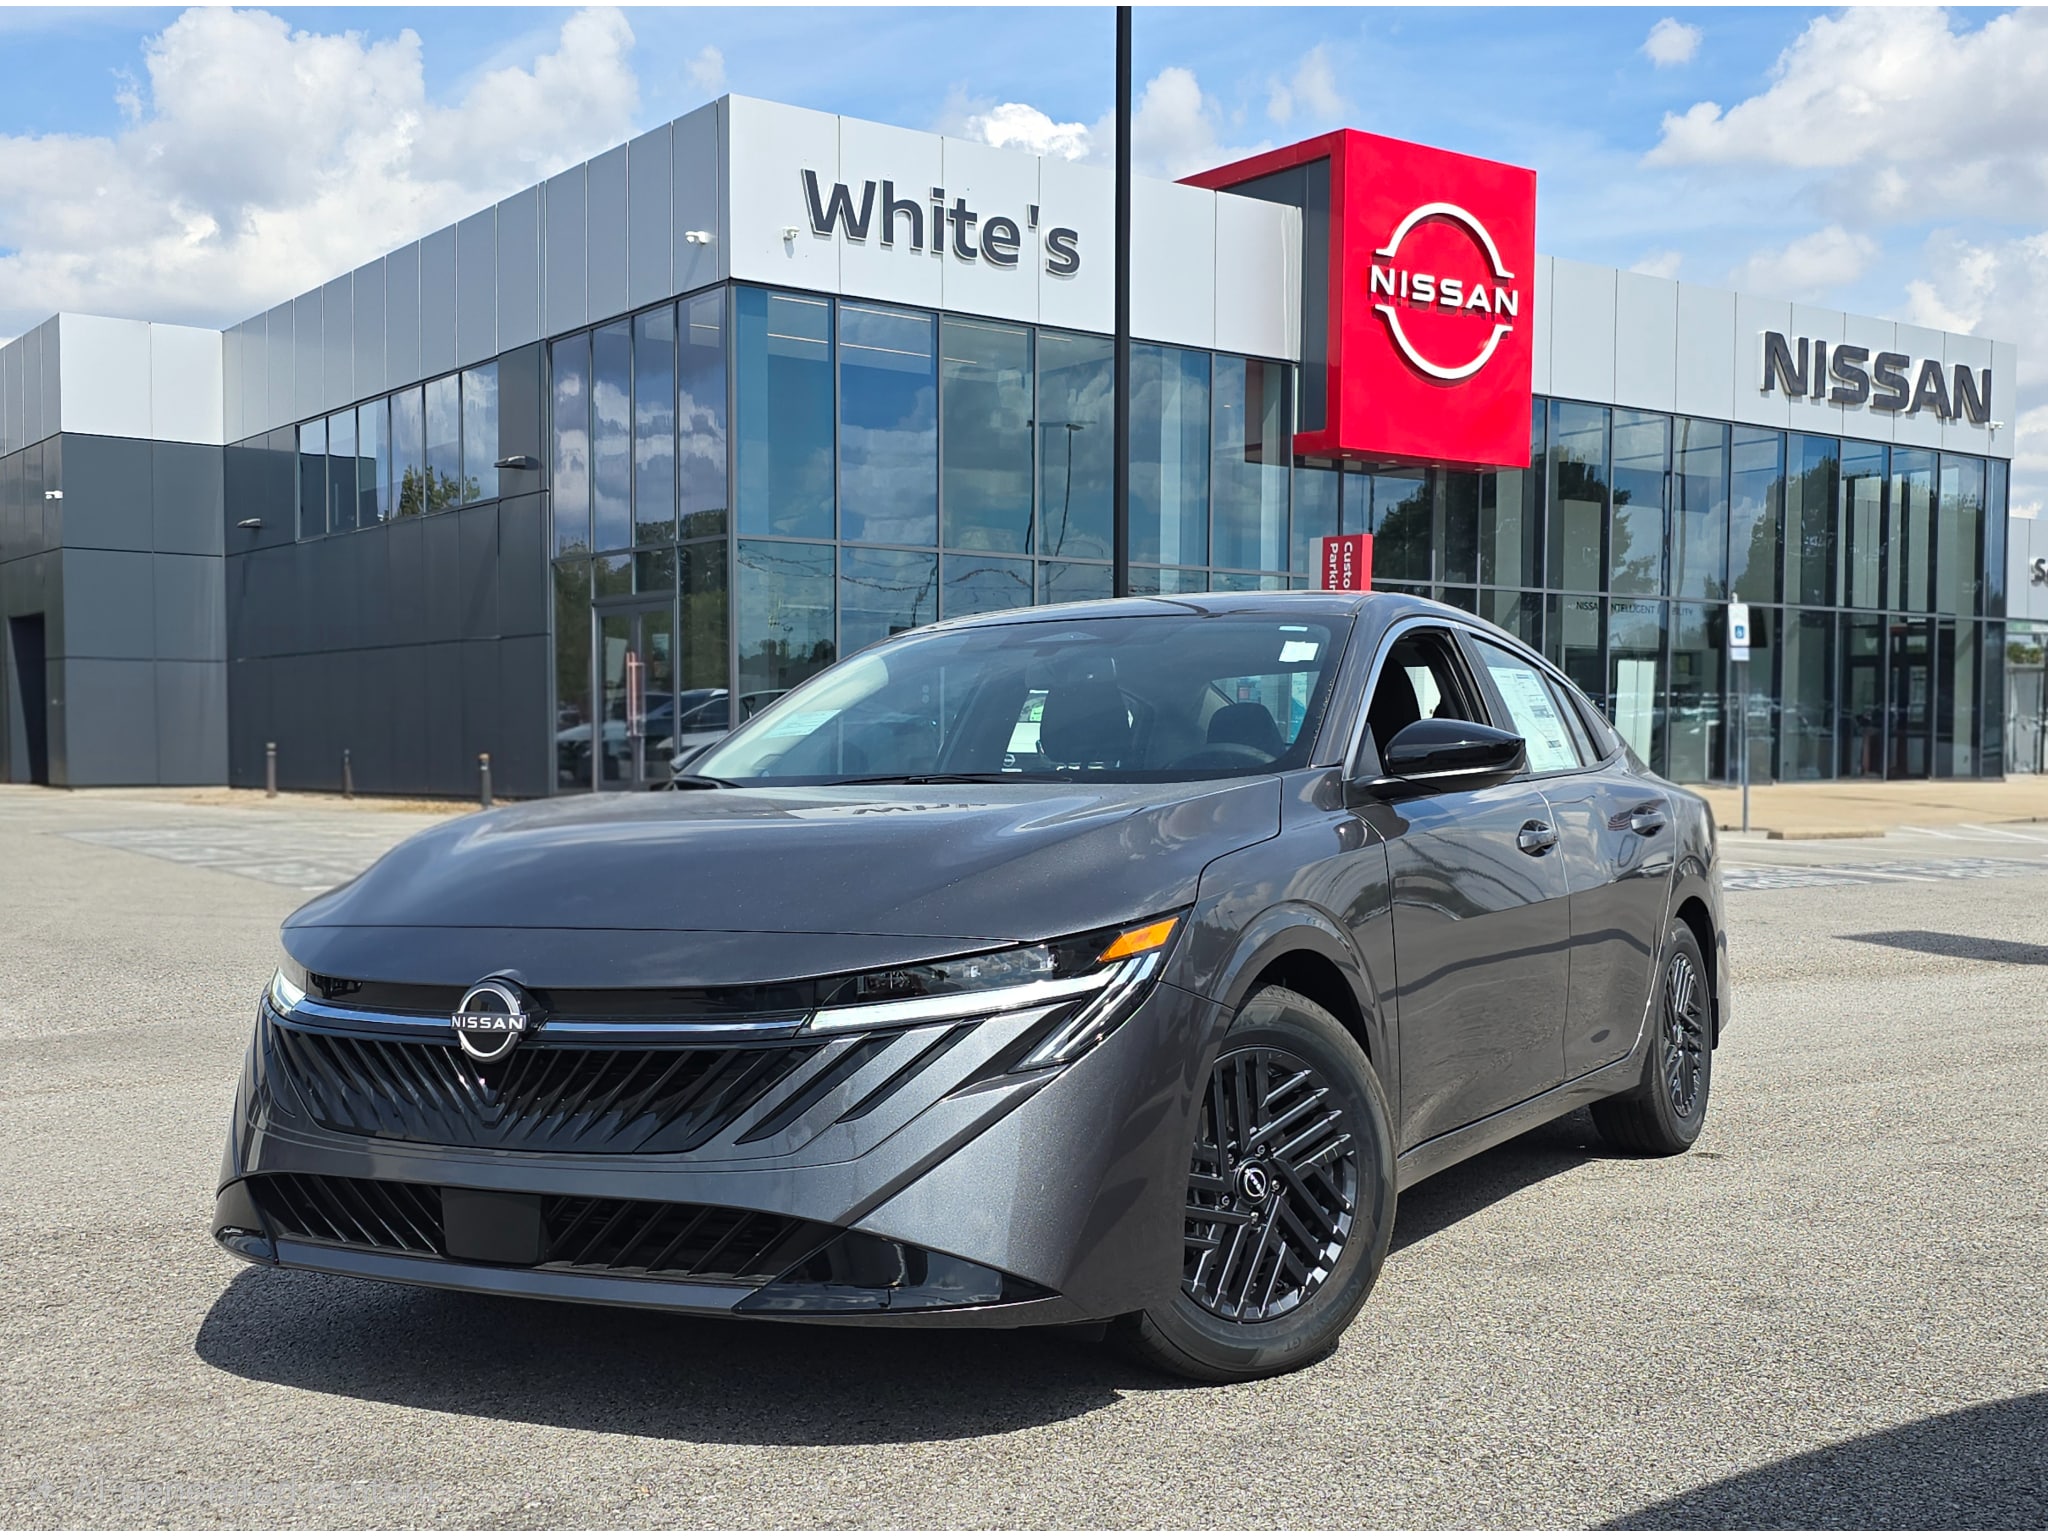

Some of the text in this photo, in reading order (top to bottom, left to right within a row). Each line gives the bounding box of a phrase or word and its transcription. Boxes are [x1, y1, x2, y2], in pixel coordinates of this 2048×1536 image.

[801, 168, 1081, 275] White's
[1370, 264, 1518, 316] NISSAN
[1760, 331, 1992, 423] NISSAN
[451, 1015, 523, 1030] NISSAN
